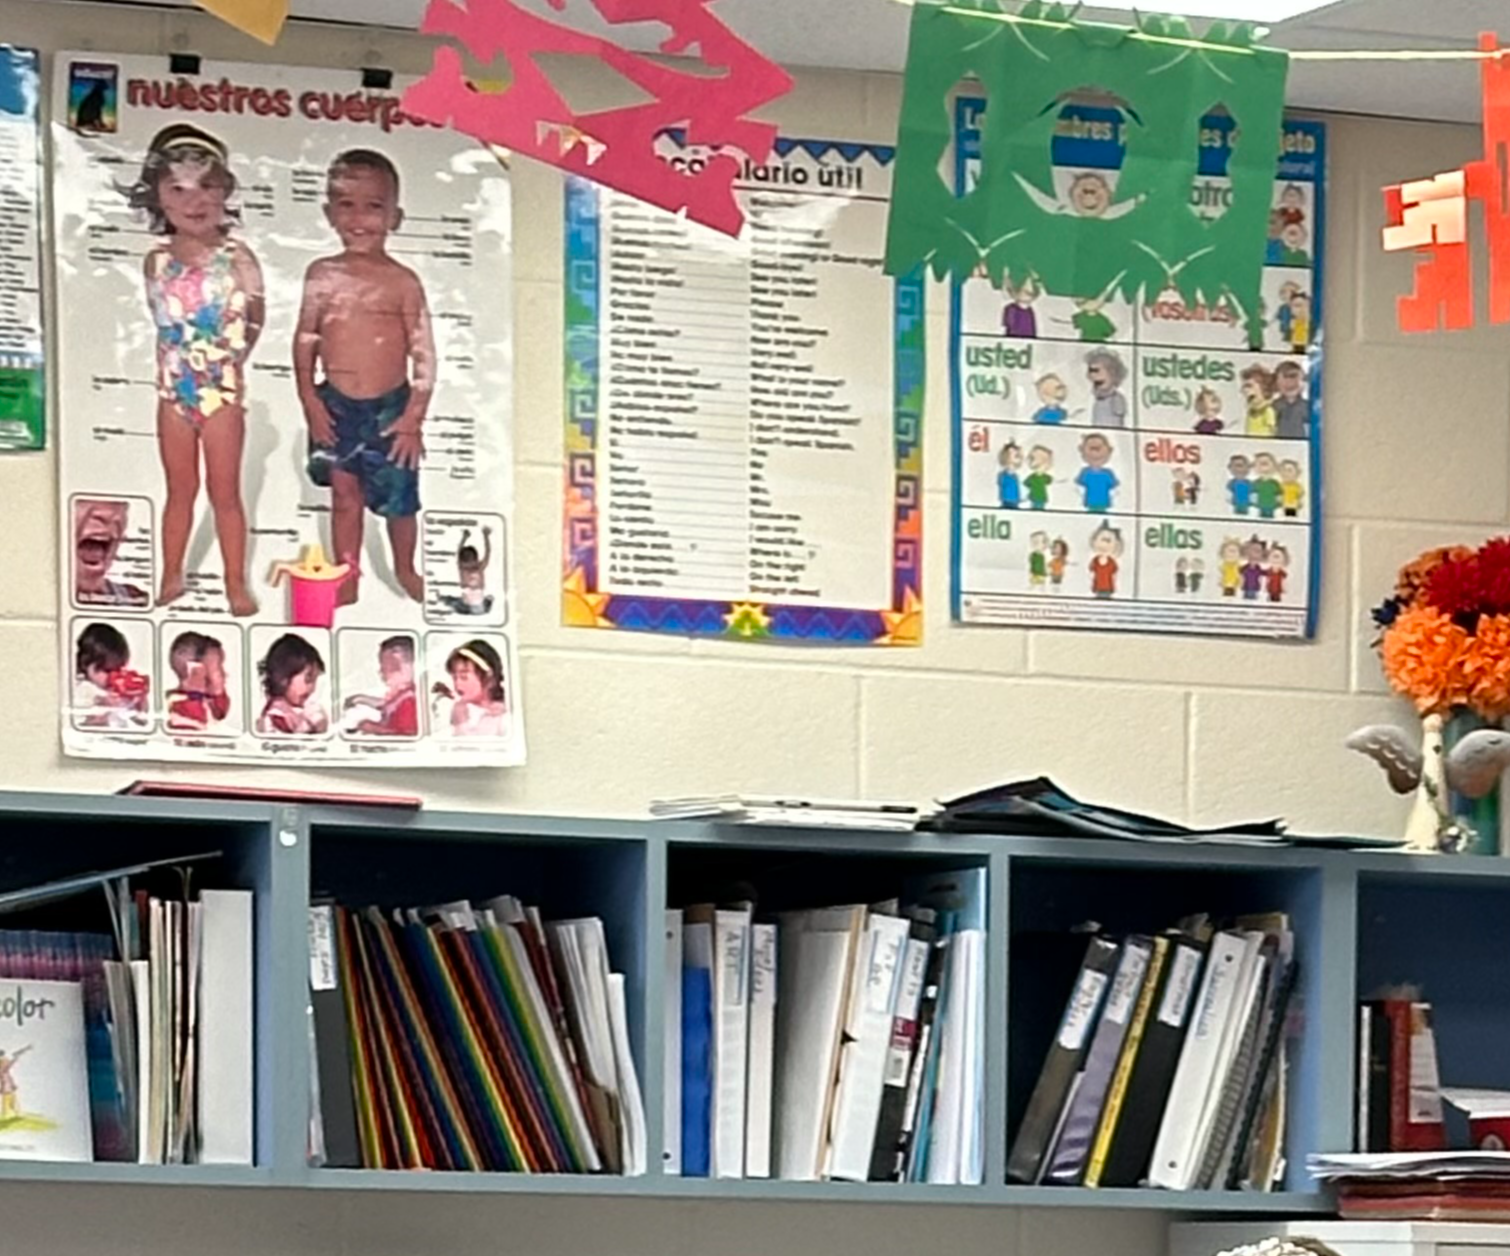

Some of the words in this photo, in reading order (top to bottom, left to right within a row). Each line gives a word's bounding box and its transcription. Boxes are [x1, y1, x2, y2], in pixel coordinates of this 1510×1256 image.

[126, 77, 293, 118] nuestros
[965, 343, 1033, 370] usted
[1142, 352, 1236, 382] ustedes
[967, 427, 990, 452] él
[1144, 438, 1201, 466] ellos
[966, 514, 1012, 541] ella
[1144, 523, 1203, 550] ellas
[0, 986, 55, 1027] olor
